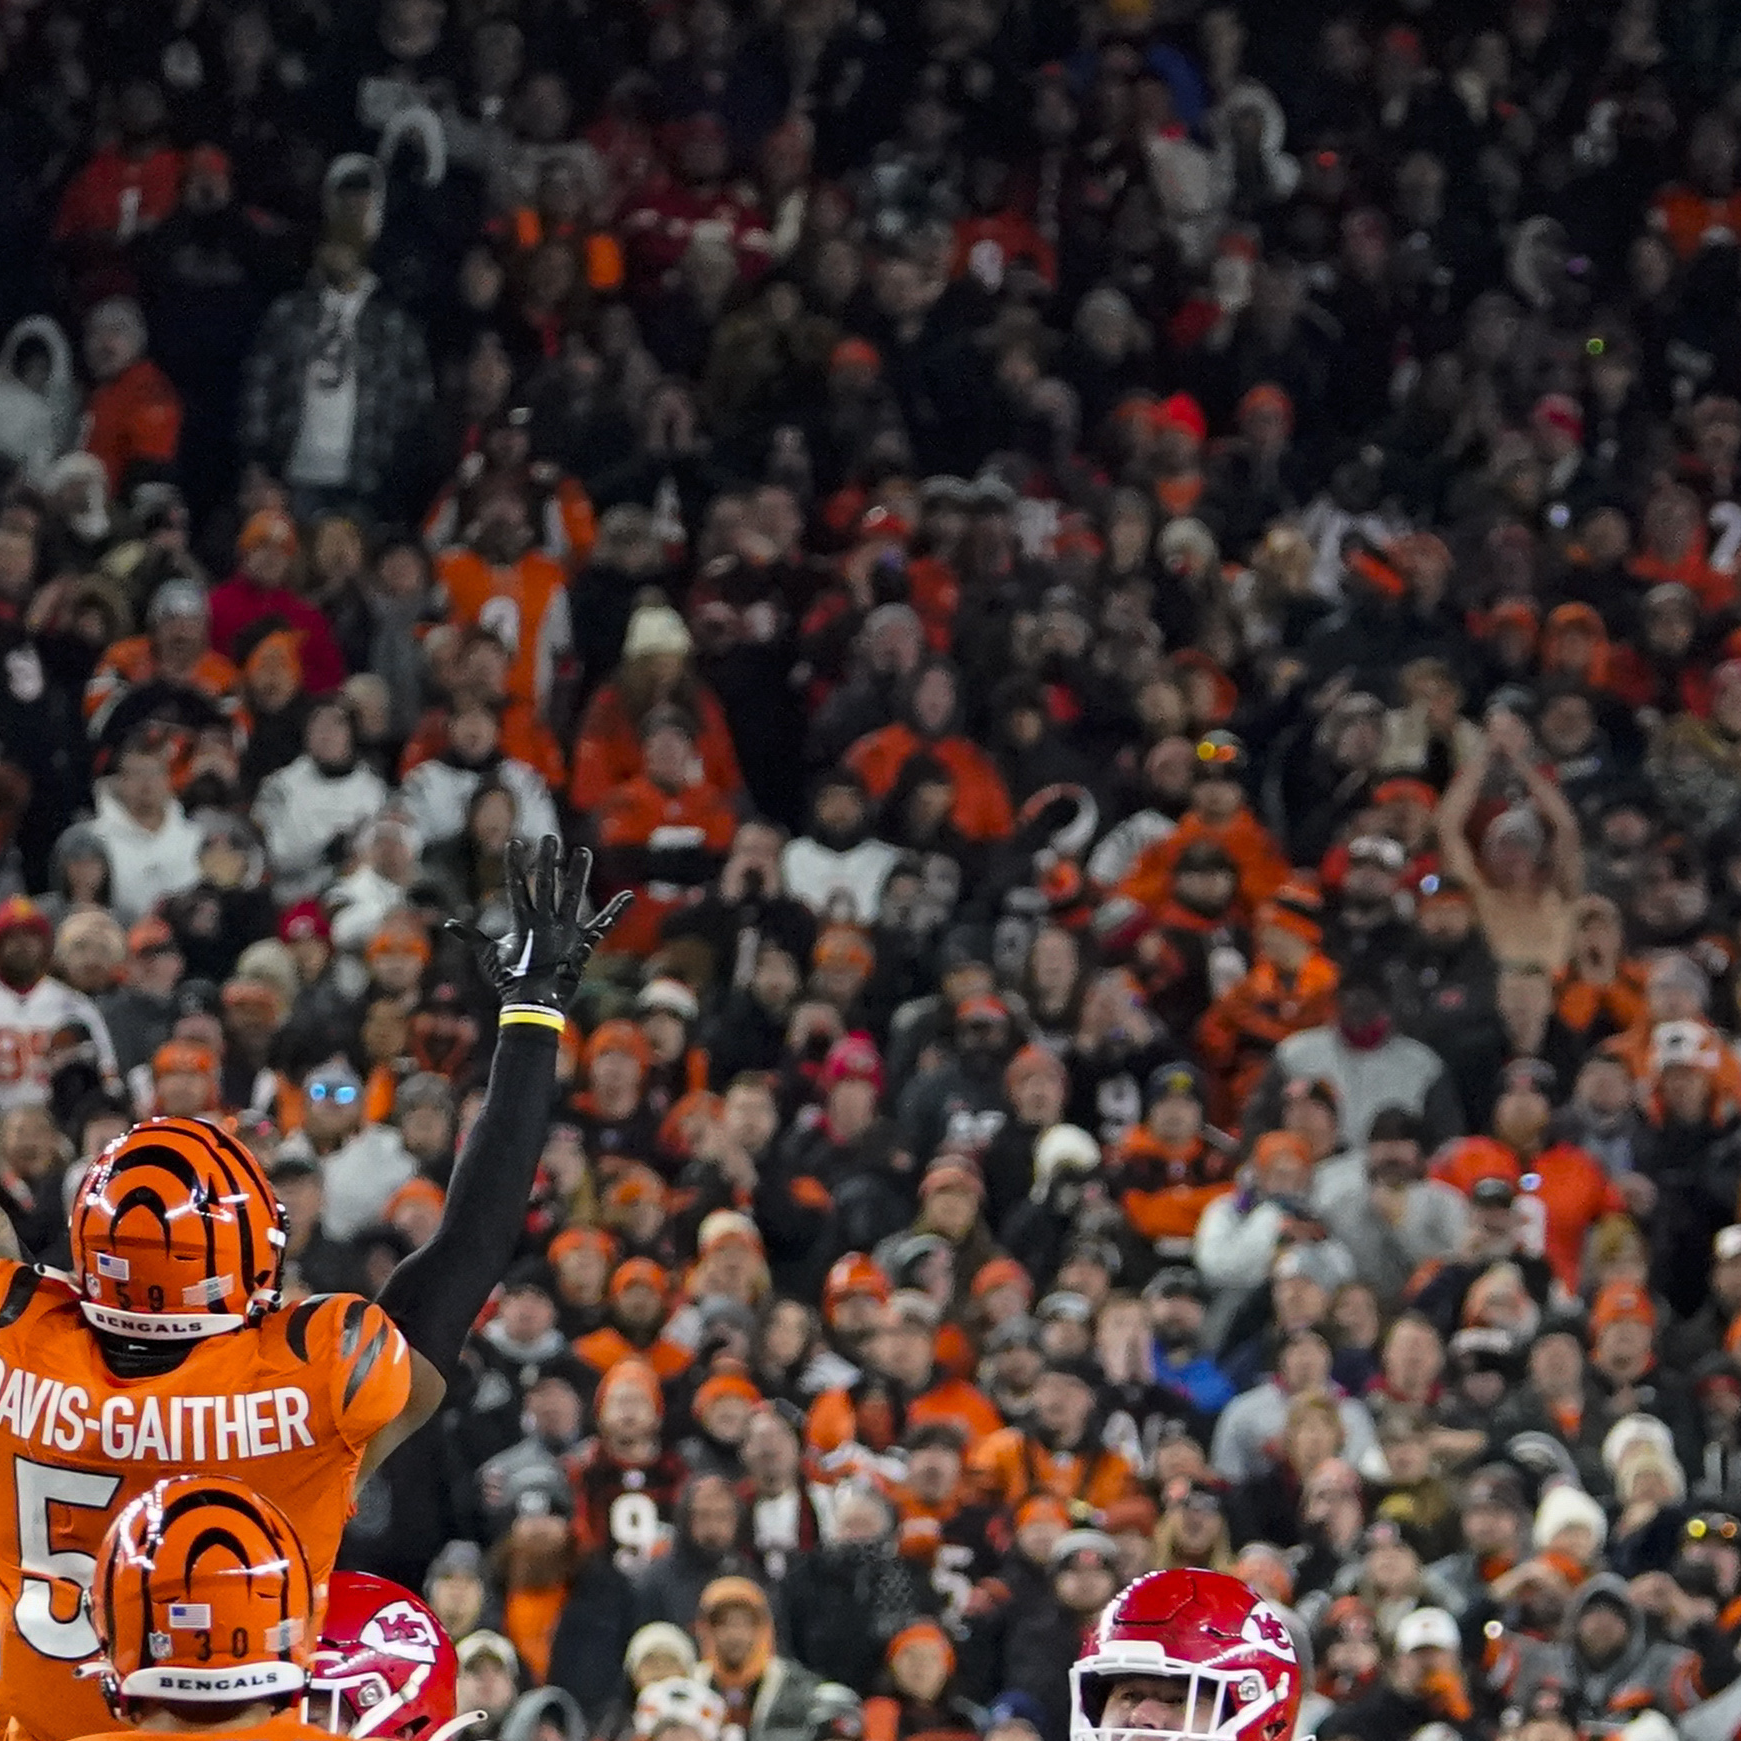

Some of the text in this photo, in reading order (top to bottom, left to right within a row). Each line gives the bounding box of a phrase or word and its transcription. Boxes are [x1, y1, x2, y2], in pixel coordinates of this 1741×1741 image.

[94, 1312, 203, 1335] BENGALS
[609, 1490, 659, 1579] 9
[158, 1672, 279, 1693] BENGALS
